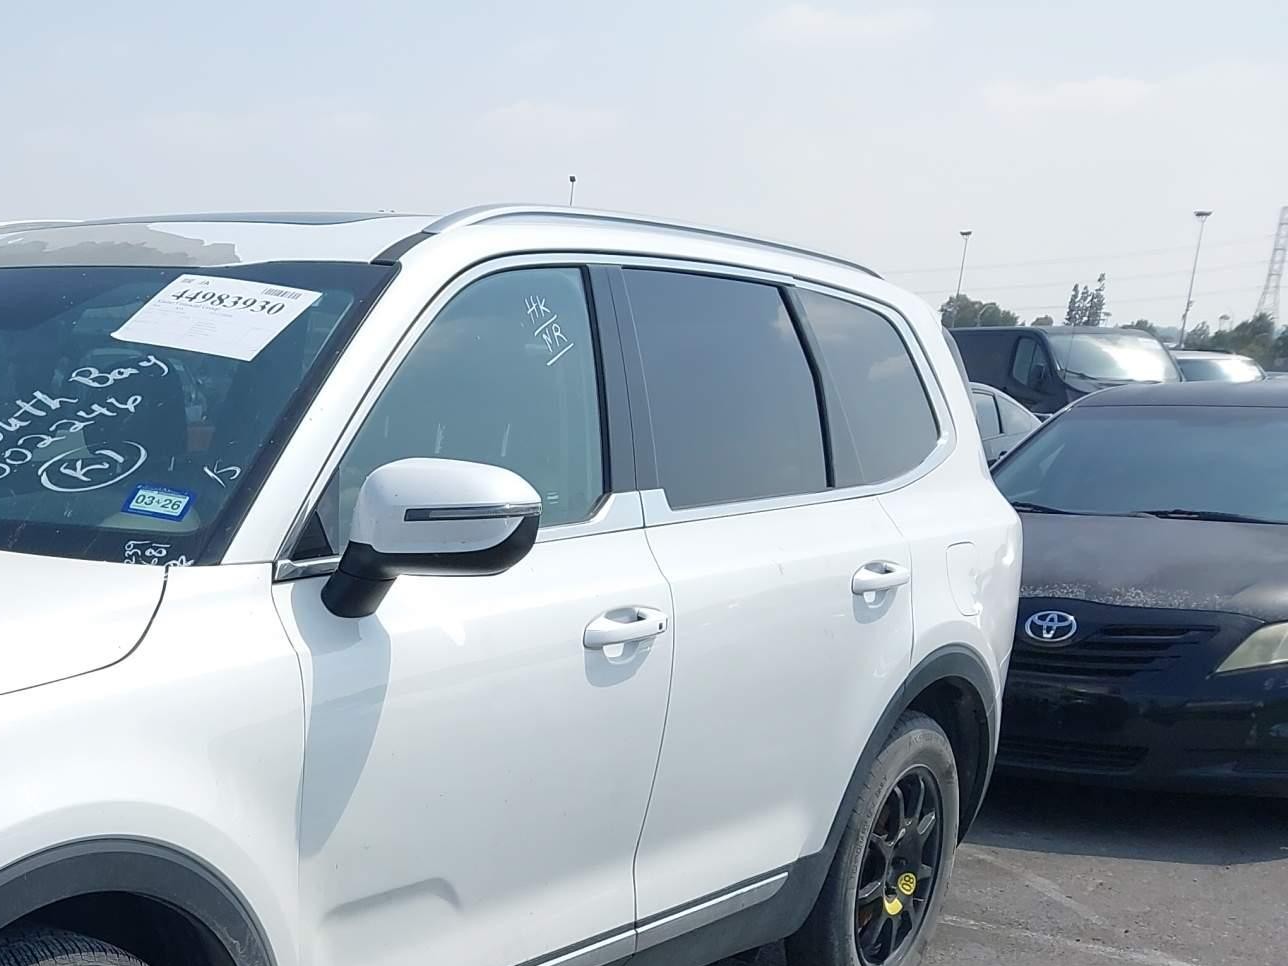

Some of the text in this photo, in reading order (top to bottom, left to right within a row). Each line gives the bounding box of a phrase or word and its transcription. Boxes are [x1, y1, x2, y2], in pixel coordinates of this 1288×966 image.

[171, 288, 285, 316] 44983930
[68, 355, 169, 388] Bay
[134, 494, 183, 512] 03 26
